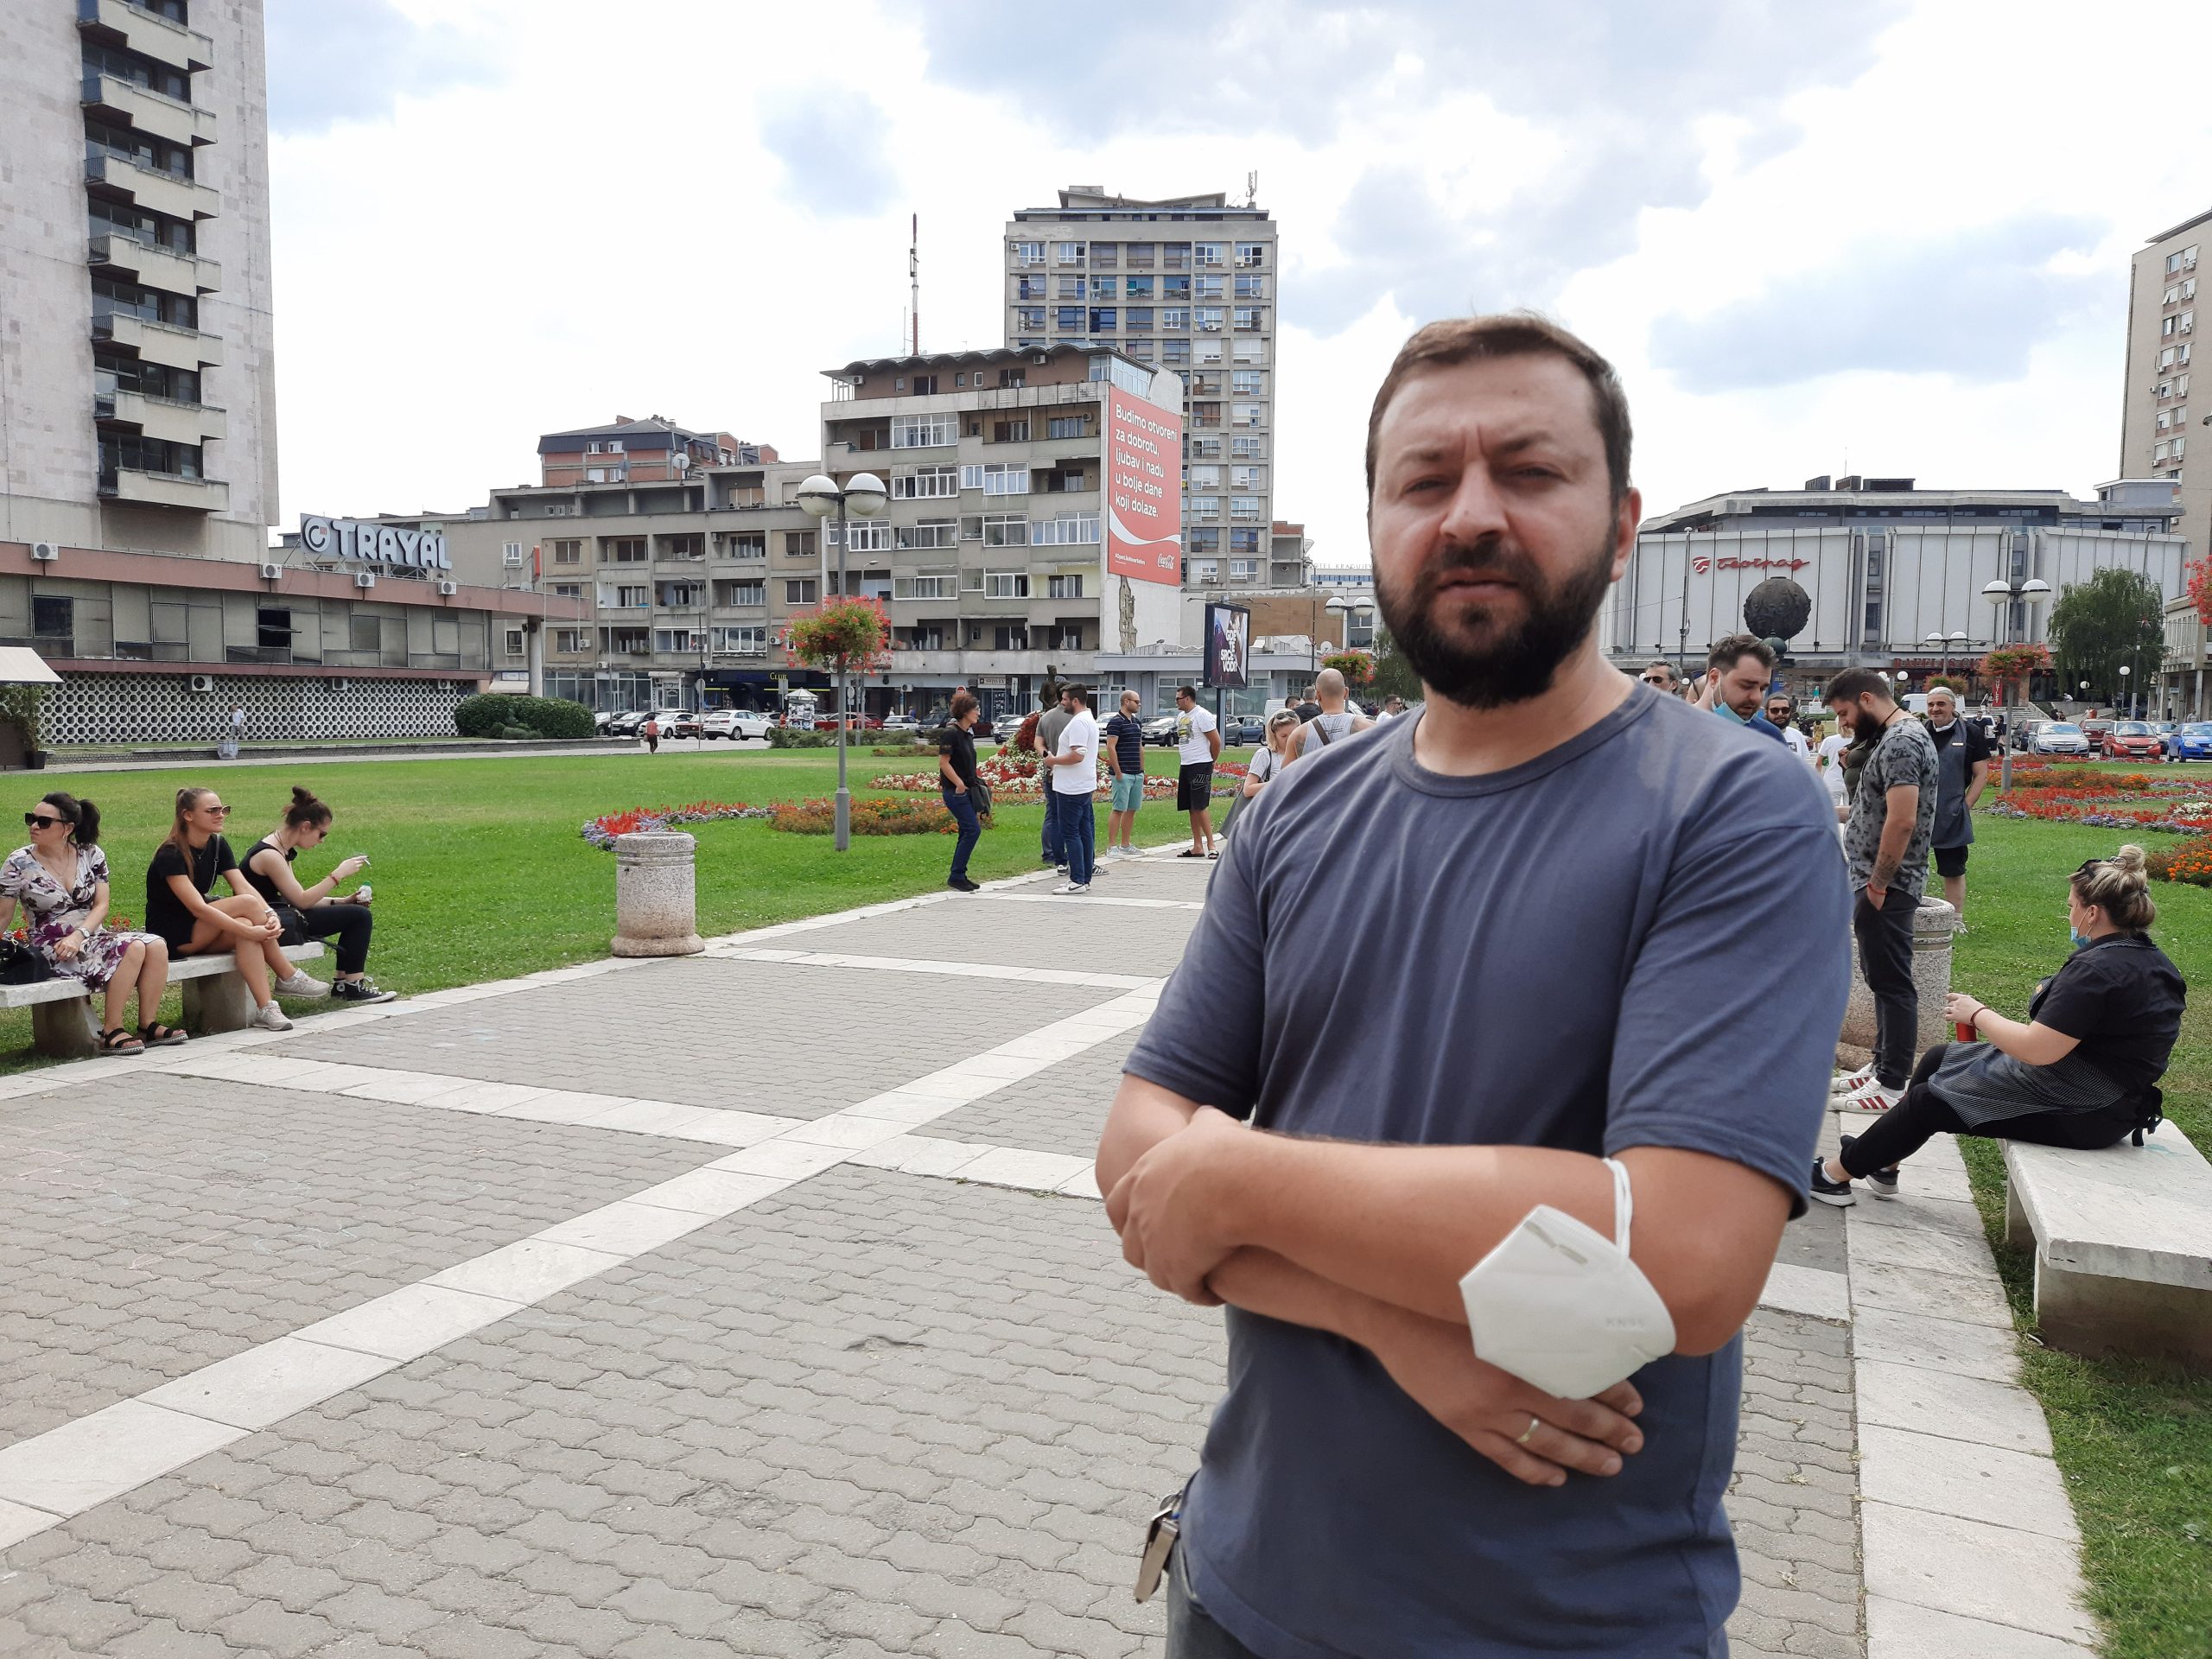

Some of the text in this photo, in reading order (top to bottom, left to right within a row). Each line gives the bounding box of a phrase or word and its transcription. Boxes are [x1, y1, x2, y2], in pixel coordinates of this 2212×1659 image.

[1116, 404, 1178, 442] Budimo otvoreni
[1116, 429, 1160, 457] za dobrotu,
[1116, 448, 1164, 478] ljubav i nadu
[1116, 472, 1163, 499] u bolje dane
[1116, 491, 1159, 518] koji dolaze.
[331, 520, 453, 570] TRAYAL
